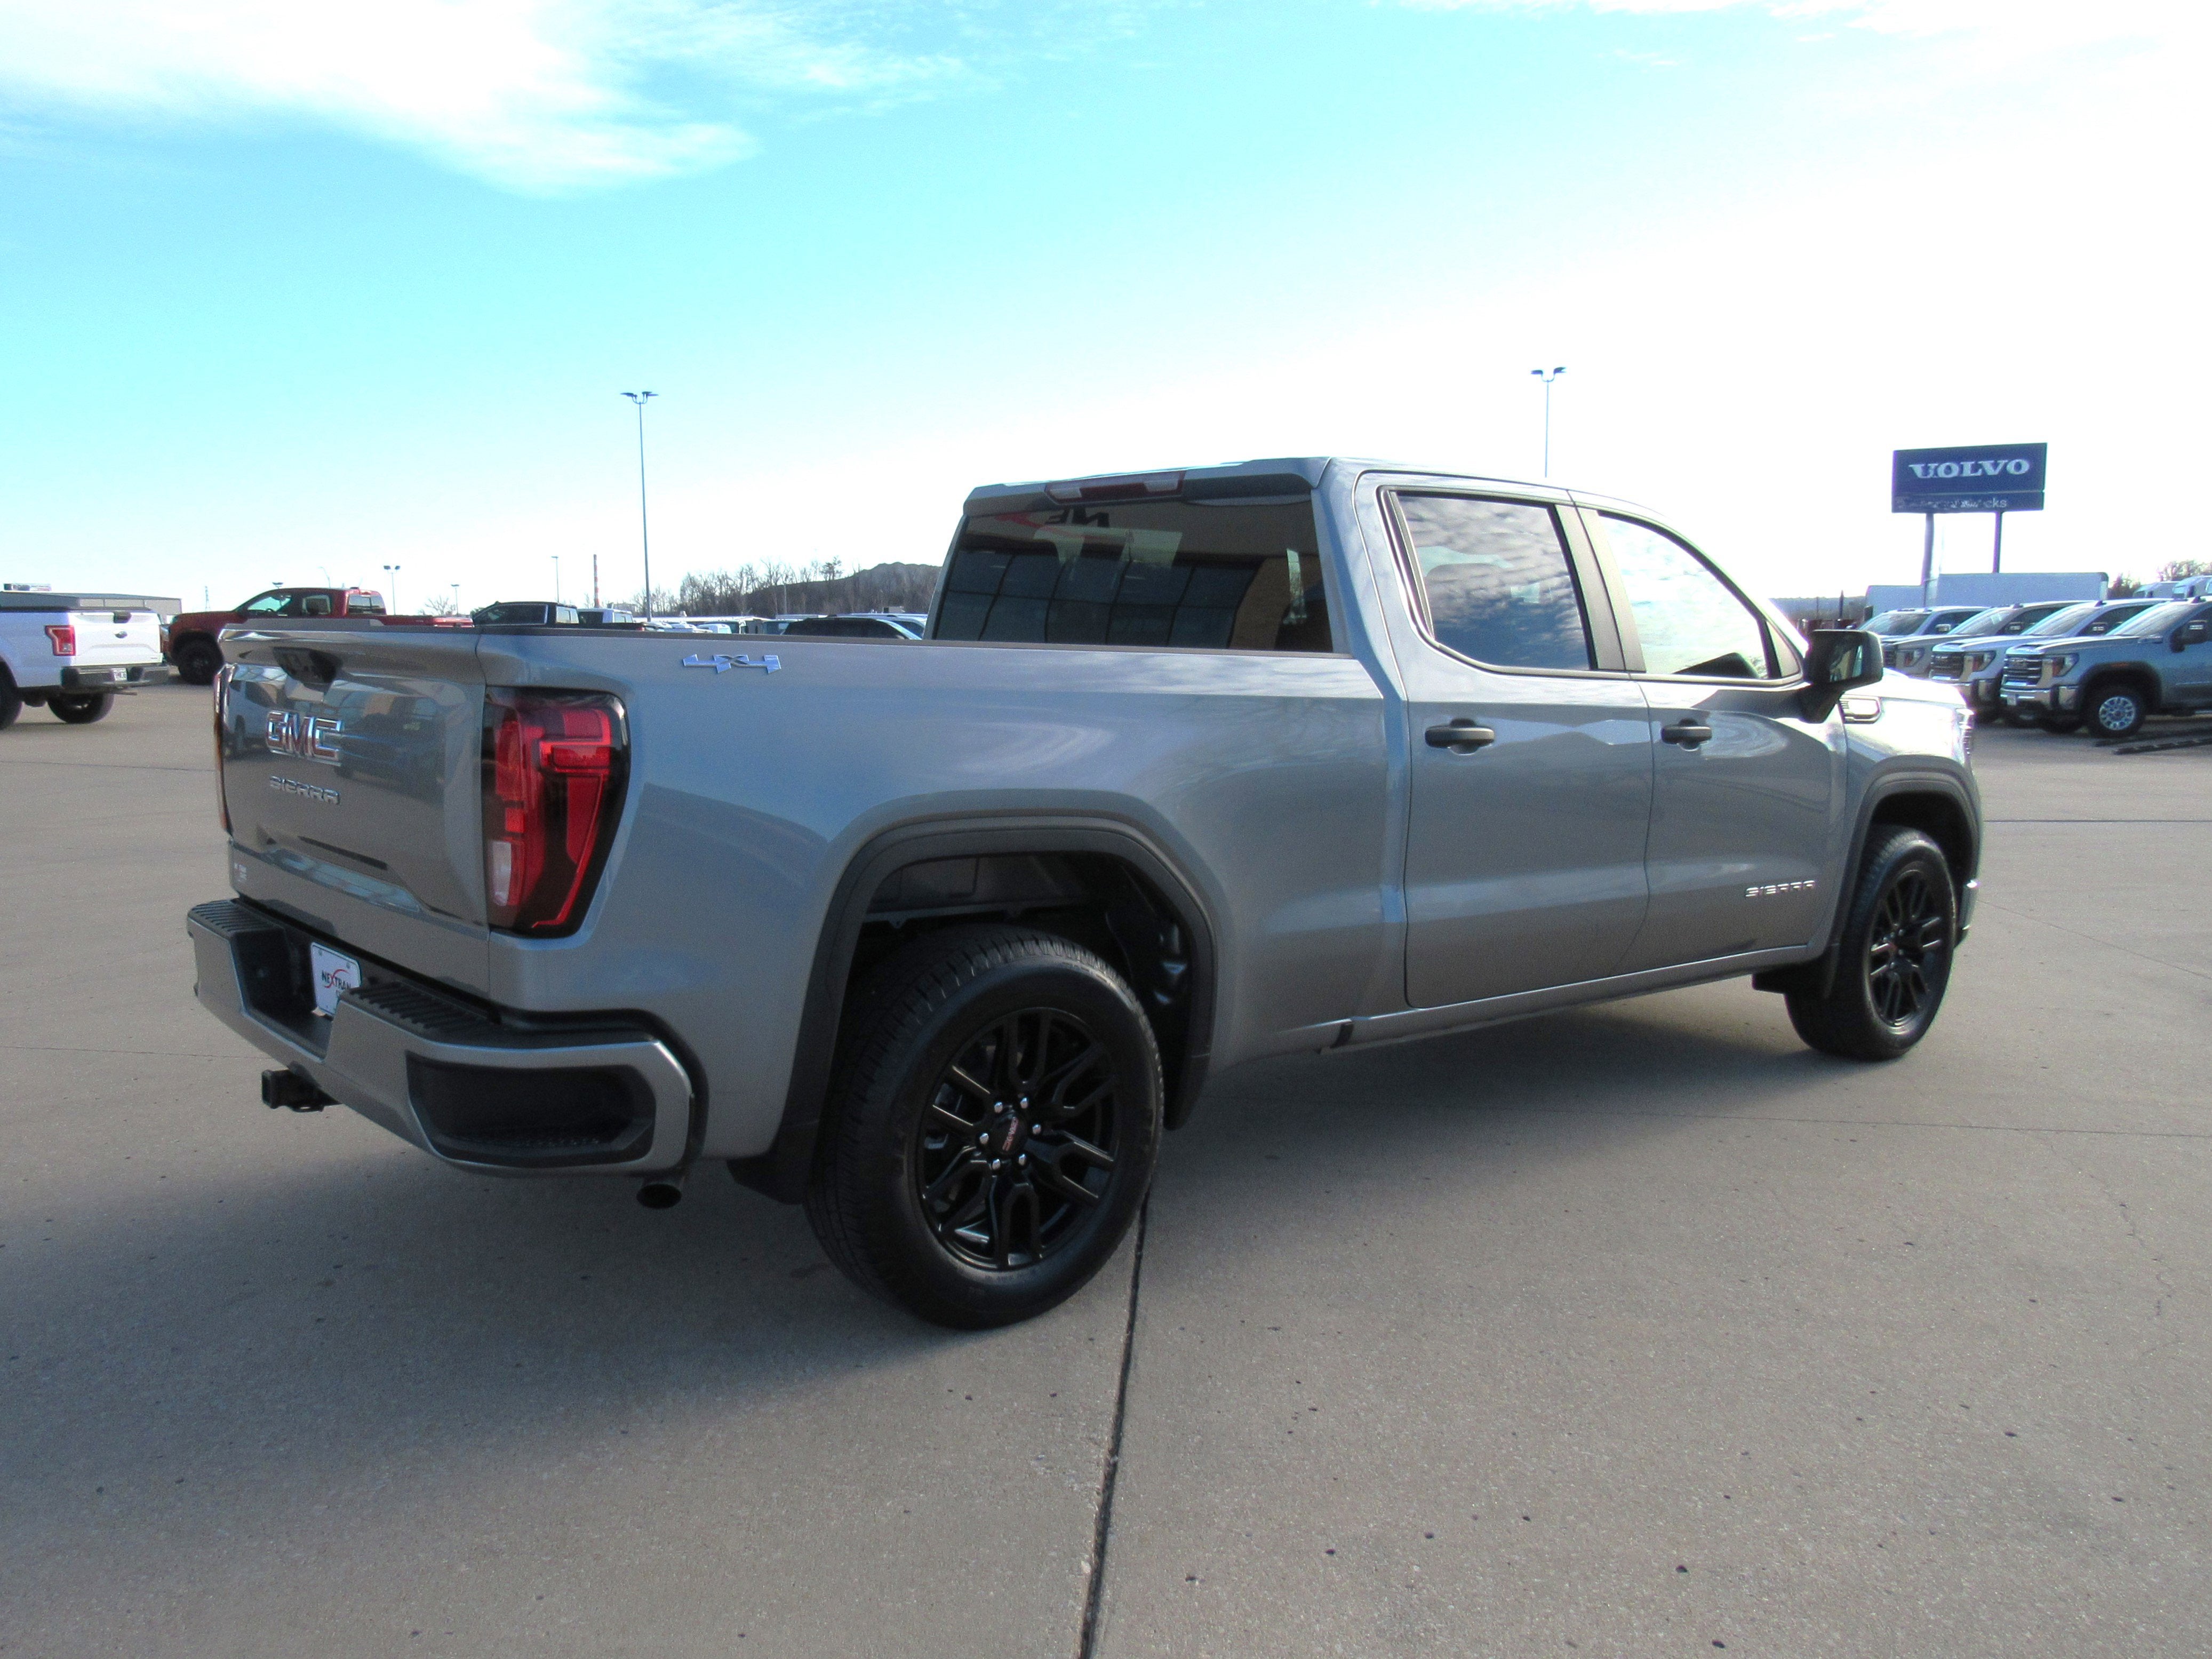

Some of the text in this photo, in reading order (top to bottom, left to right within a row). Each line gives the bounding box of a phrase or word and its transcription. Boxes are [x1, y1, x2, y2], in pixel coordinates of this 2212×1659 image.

[1908, 459, 2030, 478] VOLVO
[266, 710, 343, 764] GMC
[270, 776, 340, 805] SIERRA
[1745, 880, 1816, 898] SIERRA
[322, 969, 352, 990] NEXTRAN
[1002, 1116, 1019, 1151] GMC
